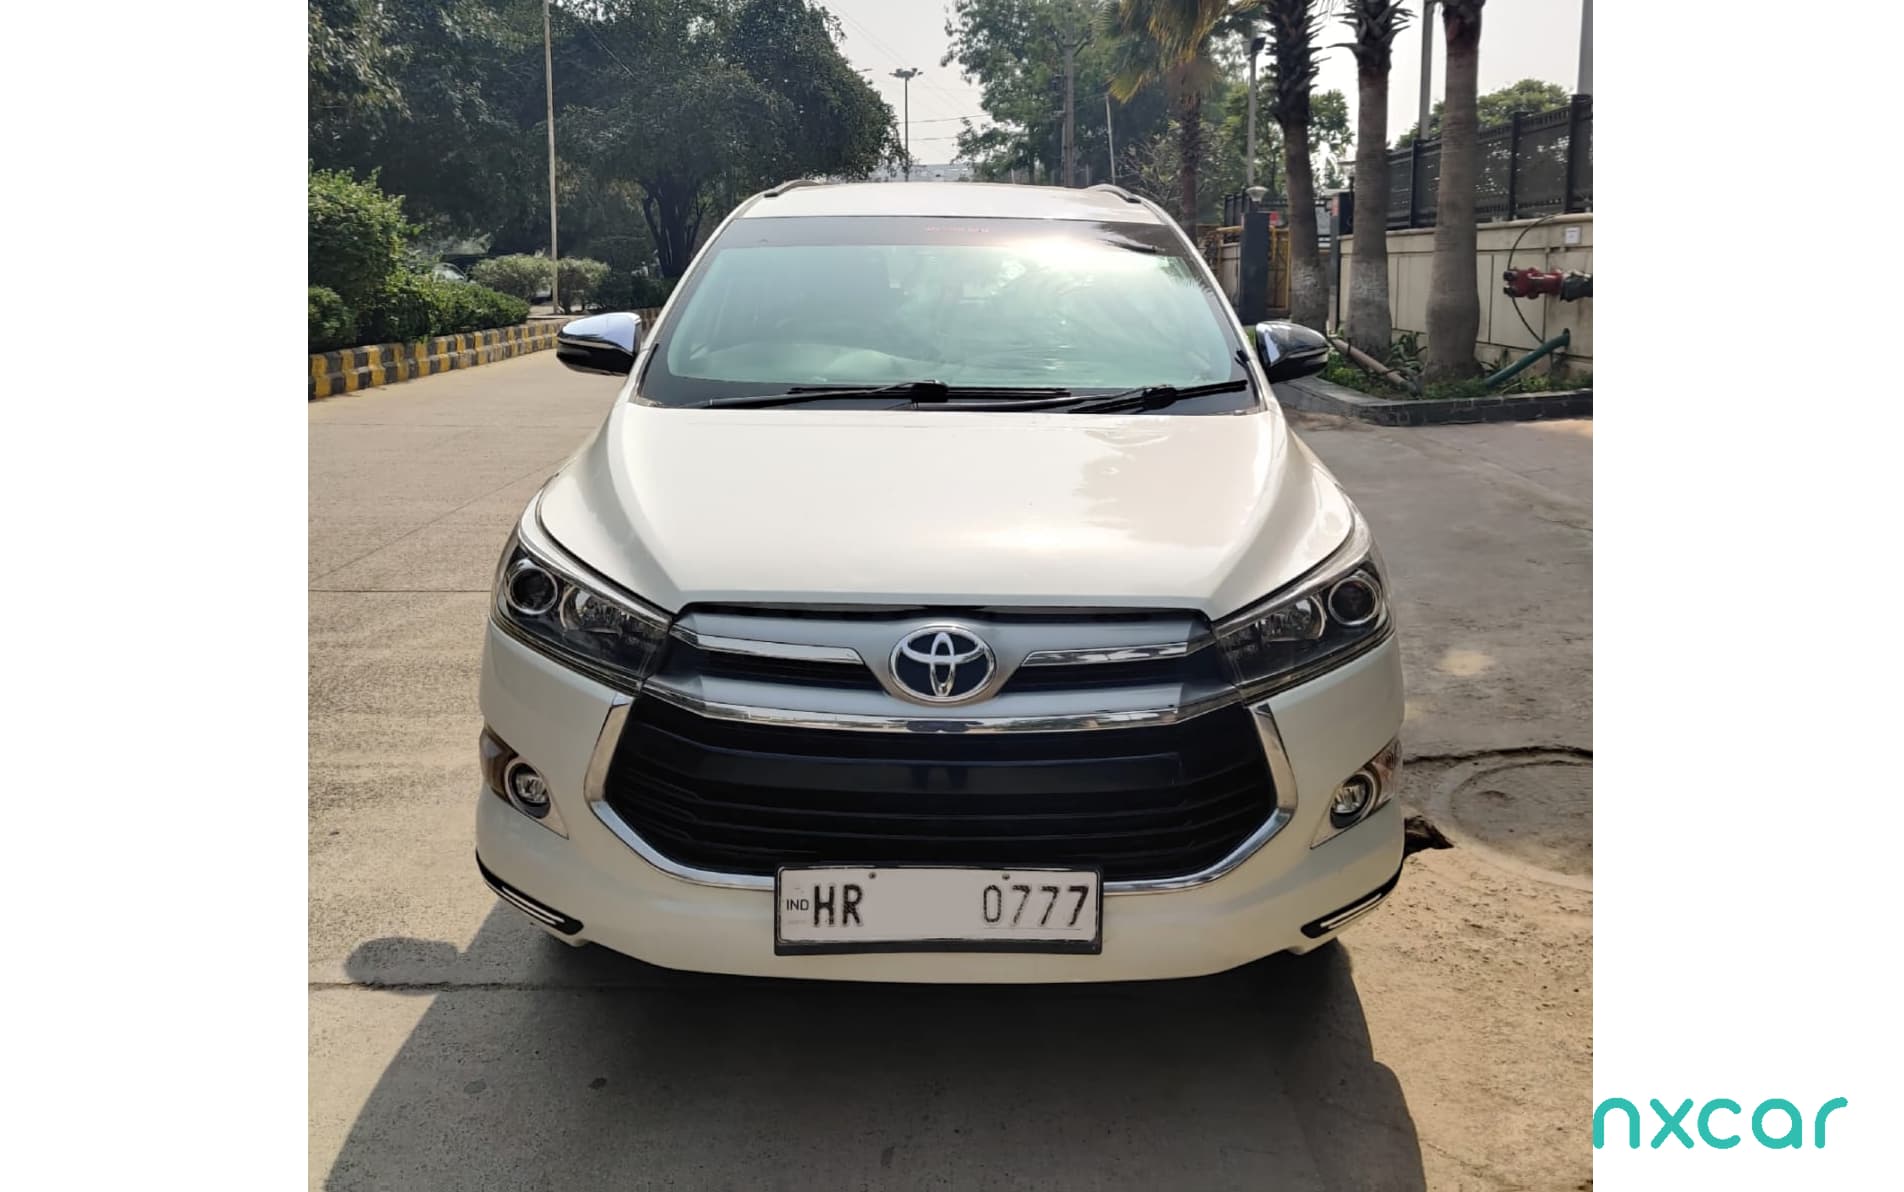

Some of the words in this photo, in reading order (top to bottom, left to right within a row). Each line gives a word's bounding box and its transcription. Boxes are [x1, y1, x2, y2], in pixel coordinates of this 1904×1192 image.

[786, 899, 809, 911] IND
[813, 885, 862, 926] HR
[983, 885, 1089, 926] 0777
